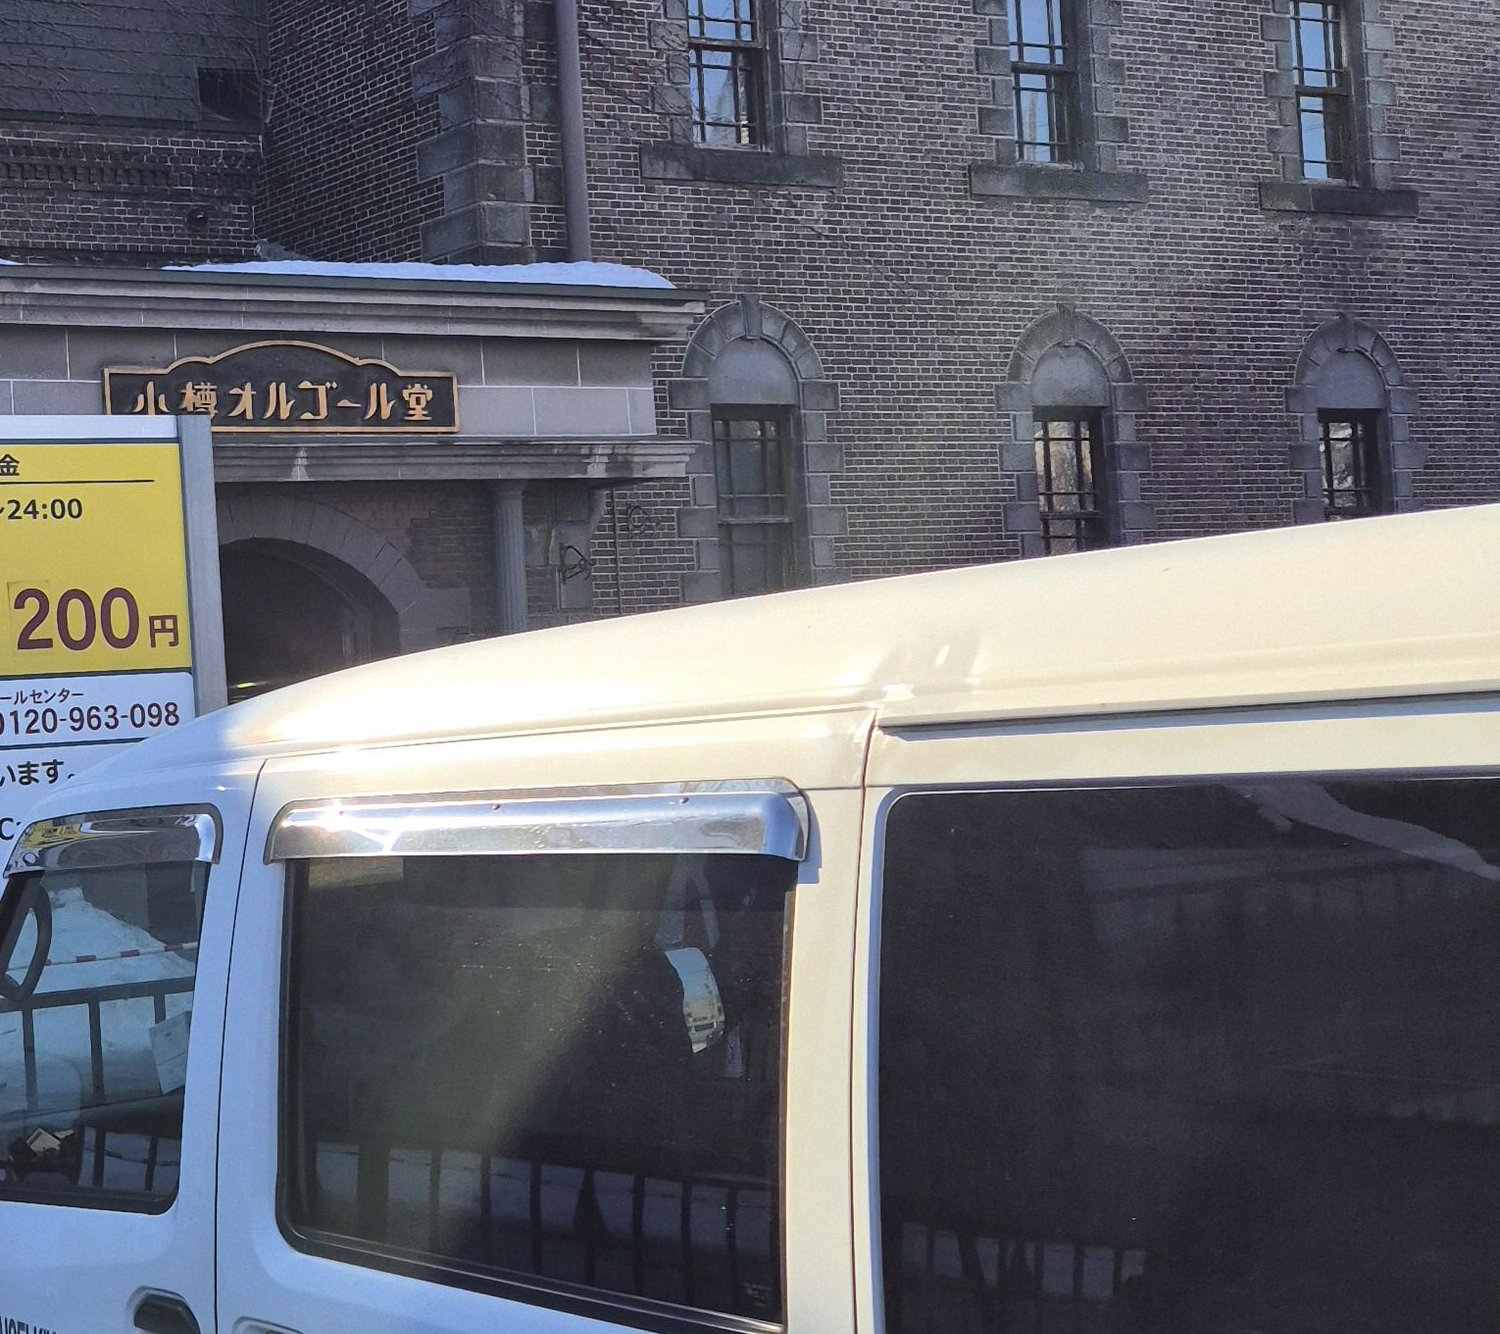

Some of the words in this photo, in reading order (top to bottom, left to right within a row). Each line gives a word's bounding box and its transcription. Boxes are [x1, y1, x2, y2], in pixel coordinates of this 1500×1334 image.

[132, 381, 434, 421] 小樽オルゴール堂
